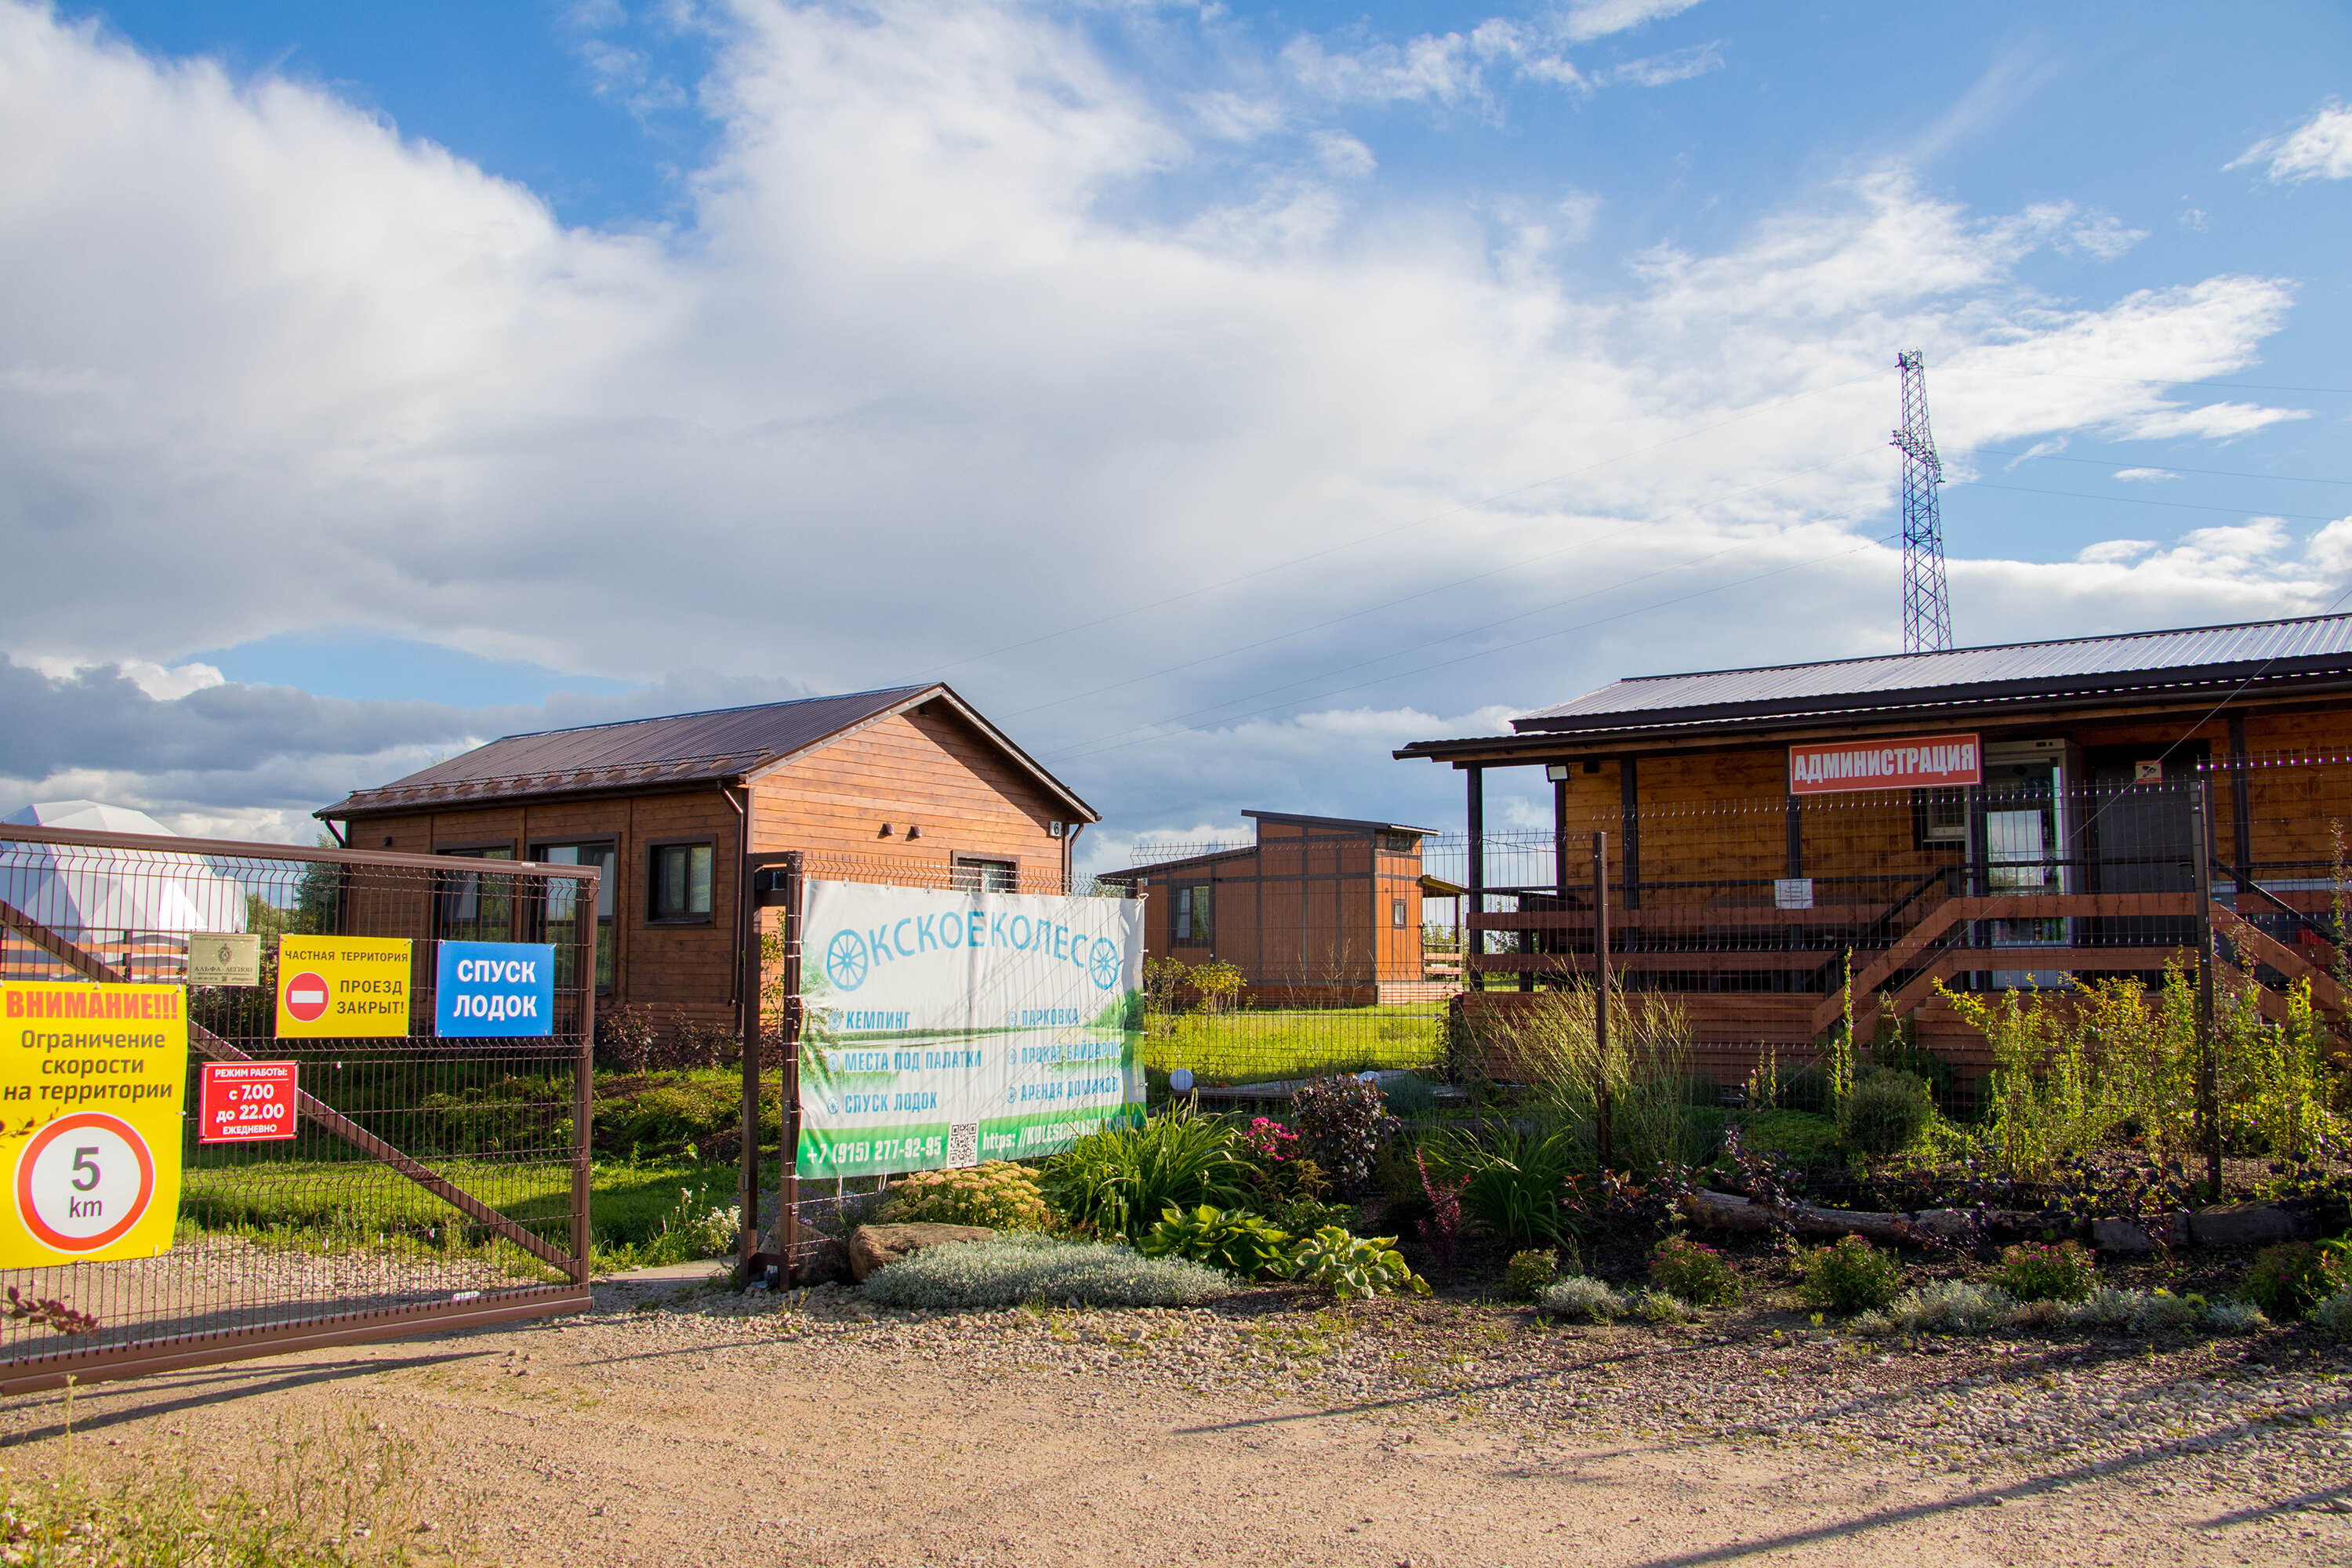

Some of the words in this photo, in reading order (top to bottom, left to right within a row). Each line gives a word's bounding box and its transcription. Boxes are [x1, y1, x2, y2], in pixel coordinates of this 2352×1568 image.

[1795, 743, 1976, 784] АДМИНИСТРАЦИЯ
[285, 949, 335, 961] ЧАСТНАЯ
[341, 951, 408, 963] ТЕРРИТОРИЯ
[457, 959, 536, 983] СПУСК
[339, 980, 403, 996] ПРОЕЗД
[6, 990, 178, 1020] ВНИМАНИЕ!!!
[336, 1001, 405, 1014] ЗАКРЫТ!
[453, 995, 537, 1021] ЛОДОК
[846, 1011, 911, 1029] КЕМПИНГ
[1022, 1007, 1079, 1027] ПАРКОВКА
[21, 1029, 166, 1054] Ограничение
[1022, 1045, 1063, 1064] ПРОКАТ
[1066, 1039, 1120, 1063] БАЙДАРОК
[42, 1058, 144, 1079] скорости
[214, 1068, 249, 1078] РЕЖИМ
[250, 1067, 288, 1077] РАБОТЫ:
[844, 1052, 888, 1072] МЕСТА
[894, 1051, 920, 1073] ПОД
[925, 1050, 982, 1069] ПАЛАТКИ
[4, 1085, 32, 1101] на
[39, 1083, 173, 1105] территории
[229, 1090, 238, 1101] с
[241, 1083, 274, 1100] 7.00
[1021, 1081, 1062, 1102] АРЕНДА
[1066, 1076, 1118, 1100] ДОМИКОВ
[215, 1110, 235, 1123] до
[238, 1103, 285, 1120] 22.00
[844, 1094, 888, 1114] СПУСК
[893, 1091, 938, 1113] ЛОДОК
[222, 1123, 278, 1135] ЕЖЕДНЕВНО
[807, 1143, 827, 1164] +7
[832, 1141, 870, 1164] (915)
[874, 1136, 942, 1161] 277-92-95
[982, 1131, 1016, 1153] https:
[71, 1146, 101, 1192] 5
[69, 1196, 103, 1218] km
